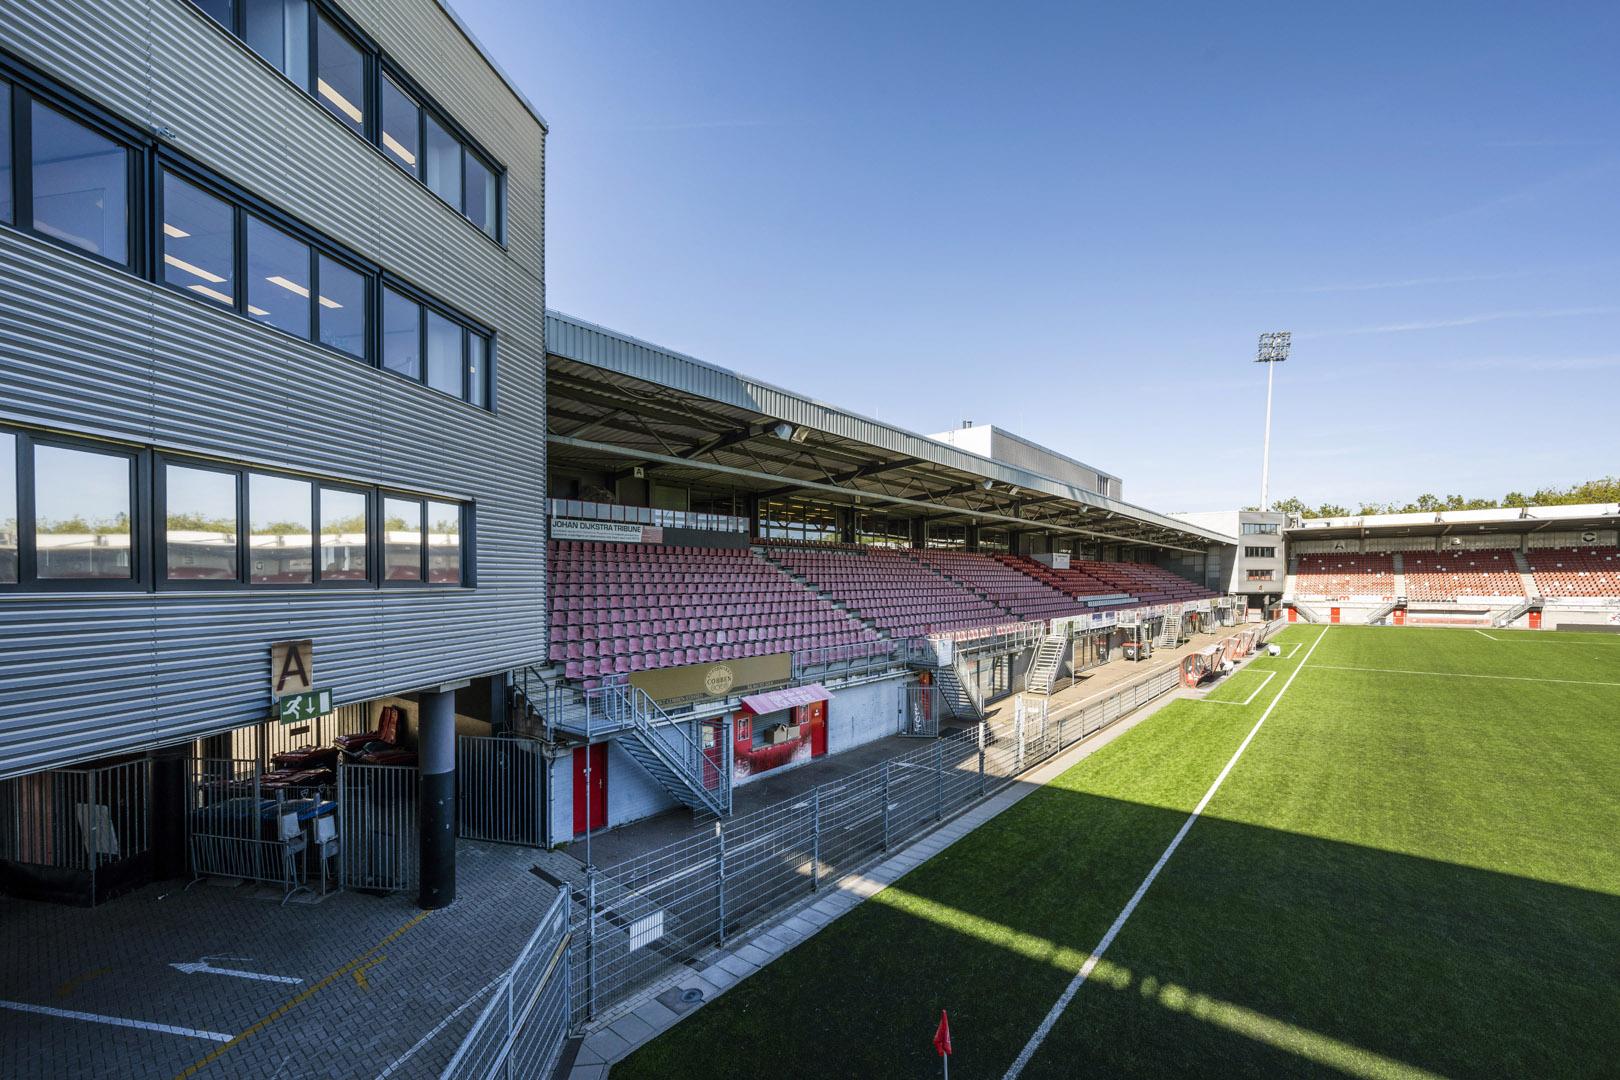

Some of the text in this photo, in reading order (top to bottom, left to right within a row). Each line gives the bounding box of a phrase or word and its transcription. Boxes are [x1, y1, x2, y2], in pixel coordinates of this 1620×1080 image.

[552, 520, 641, 532] JOHAN DIJKSTRA TRIBUNE
[276, 643, 309, 691] A
